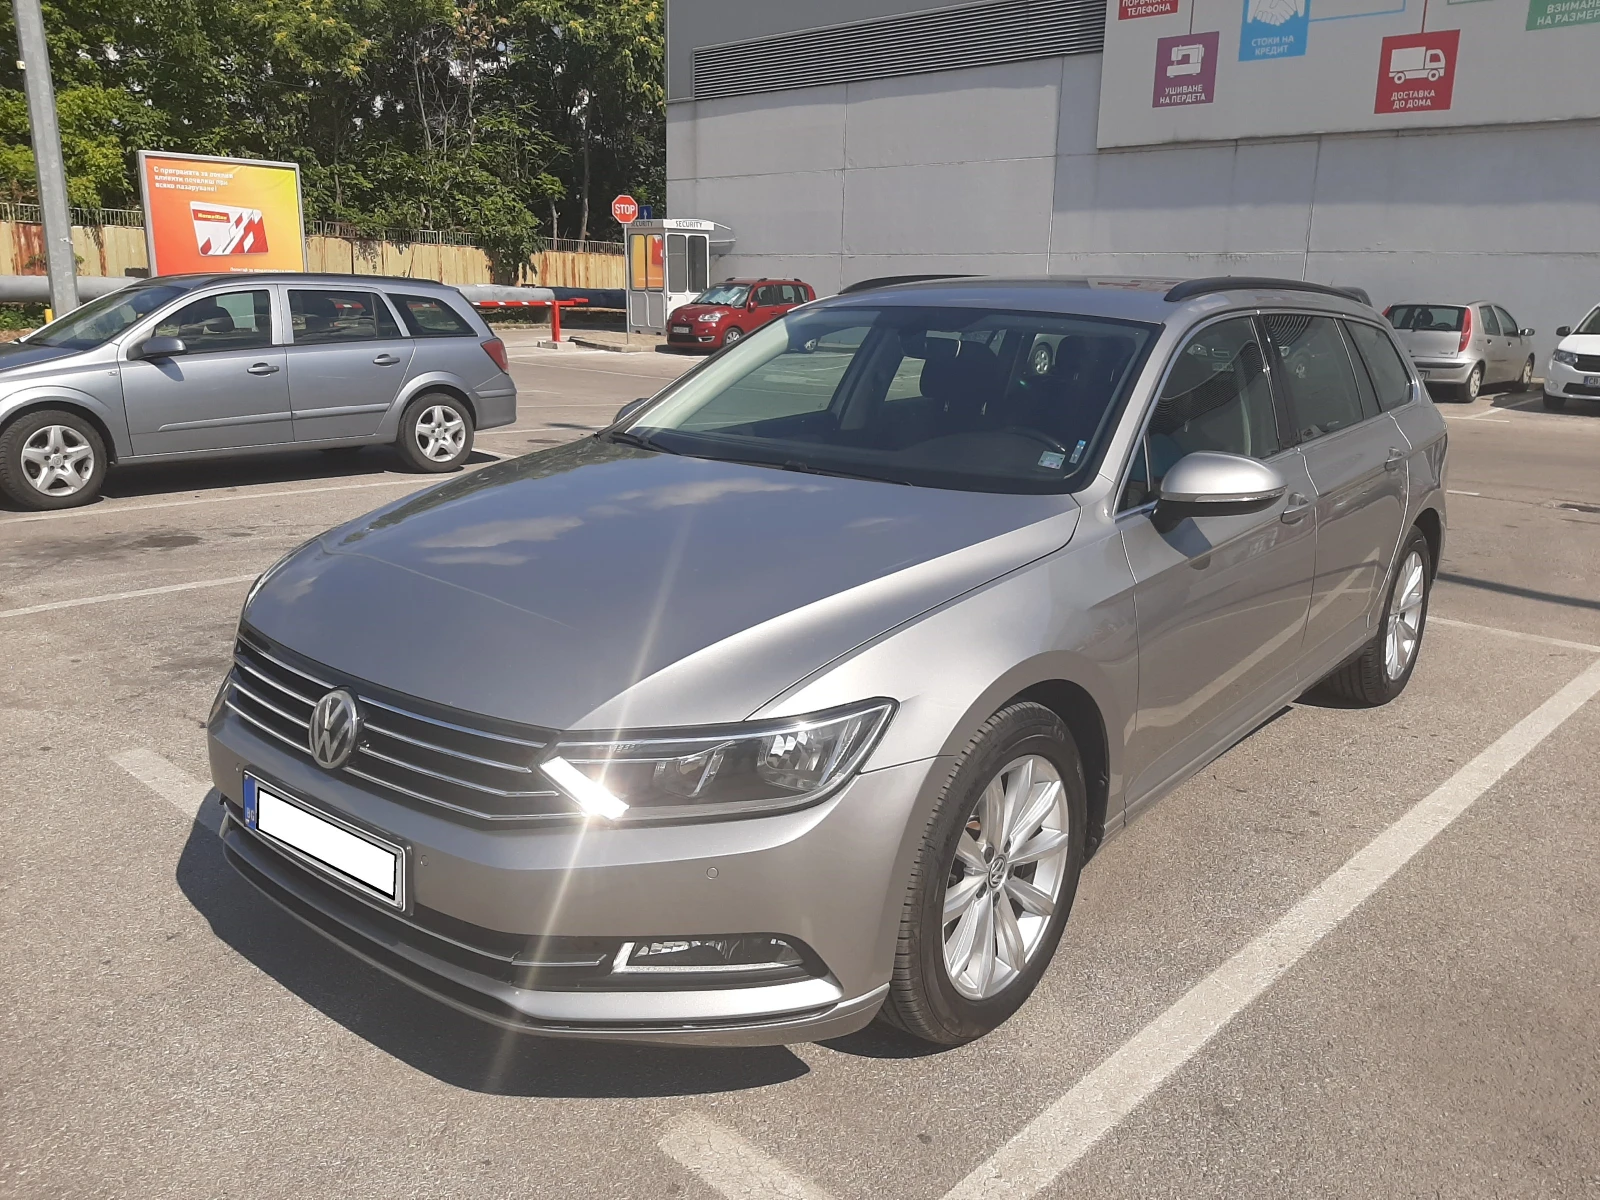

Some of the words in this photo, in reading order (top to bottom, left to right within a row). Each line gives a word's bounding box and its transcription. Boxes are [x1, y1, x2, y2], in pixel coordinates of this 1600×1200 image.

[1127, 3, 1171, 16] ТЕЛЕФОНА
[1537, 15, 1552, 25] НА
[1251, 36, 1280, 47] СТОКИ
[1282, 35, 1295, 44] НА
[1255, 45, 1289, 56] КРЕДИТ
[1165, 84, 1203, 94] УШИВАНЕ
[1159, 96, 1170, 104] НА
[1171, 93, 1206, 103] ПЕРДЕТА
[1391, 89, 1436, 101] ДОСТАВКА
[1392, 100, 1405, 109] ДО
[1406, 99, 1432, 108] ДОМА
[614, 203, 636, 215] STOP
[675, 220, 703, 228] SECURITY
[246, 806, 255, 822] BG
